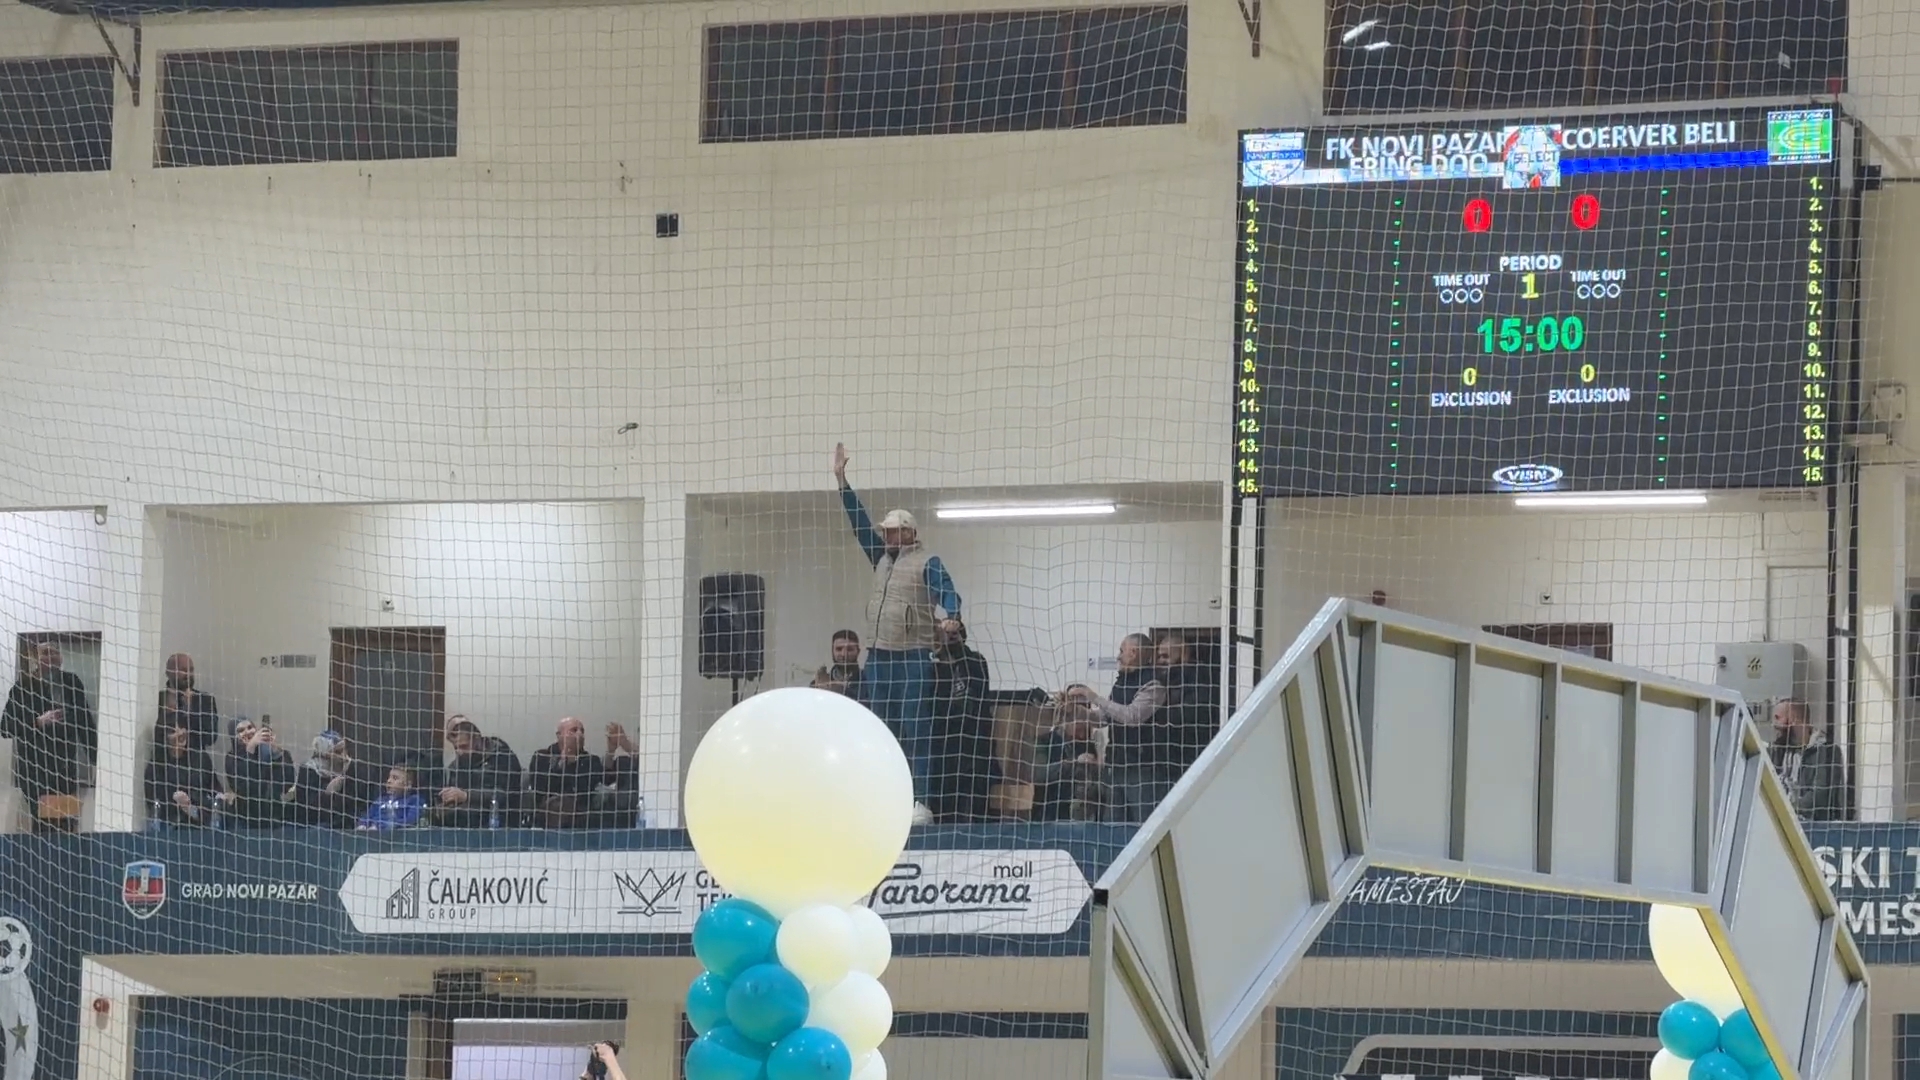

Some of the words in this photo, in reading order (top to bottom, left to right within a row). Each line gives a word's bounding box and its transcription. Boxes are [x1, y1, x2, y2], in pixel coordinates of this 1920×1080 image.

[1562, 124, 1677, 149] COERVER
[1685, 121, 1735, 145] BELI
[1326, 137, 1354, 160] FK
[1362, 134, 1424, 158] NOVI
[1513, 150, 1556, 164] SELECT
[1809, 177, 1823, 190] 1.
[1247, 199, 1259, 212] 1.
[1809, 197, 1823, 211] 2.
[1463, 199, 1492, 232] 0
[1571, 194, 1600, 230] 0
[1246, 219, 1259, 233] 2.
[1809, 218, 1822, 232] 3.
[1246, 239, 1258, 253] 3.
[1808, 238, 1822, 253] 4.
[1245, 259, 1258, 273] 4.
[1500, 255, 1562, 271] PERIOD
[1808, 259, 1822, 274] 5.
[1433, 275, 1462, 286] TIME
[1464, 274, 1490, 285] OUT
[1570, 270, 1600, 281] TIME
[1602, 269, 1626, 281] OUT
[1246, 279, 1258, 292] 5.
[1521, 272, 1539, 299] 1
[1808, 280, 1822, 295] 6.
[1245, 299, 1257, 313] 6.
[1808, 301, 1822, 315] 7.
[1245, 319, 1257, 332] 7.
[1808, 321, 1821, 336] 8.
[1477, 316, 1584, 353] 15:00
[1244, 339, 1257, 352] 8.
[1808, 342, 1821, 357] 9.
[1244, 359, 1255, 372] 9.
[1803, 363, 1825, 378] 10.
[1463, 367, 1477, 386] 0
[1580, 364, 1595, 382] 0
[1240, 379, 1260, 392] 10.
[1803, 383, 1825, 398] 11.
[1431, 391, 1512, 407] EXCLUSION
[1548, 387, 1630, 404] EXCLUSION
[1240, 399, 1260, 412] 11.
[1803, 405, 1825, 419] 12.
[1239, 419, 1259, 432] 12.
[1803, 425, 1825, 440] 13.
[1239, 439, 1259, 452] 13.
[1803, 446, 1824, 460] 14.
[1239, 459, 1259, 473] 14.
[1803, 467, 1823, 481] 15.
[1239, 479, 1258, 493] 15.
[993, 861, 1033, 879] mall
[1813, 846, 1891, 888] SKI
[182, 883, 223, 899] GRAD
[227, 884, 264, 899] NOVI
[268, 884, 318, 900] PAZAR
[428, 869, 549, 905] ČALAKOVIĆ
[868, 863, 1032, 908] Panorama
[1347, 870, 1466, 905] AMEŠTAJ
[428, 908, 477, 920] GROUP
[1839, 893, 1920, 936] MEŠ
